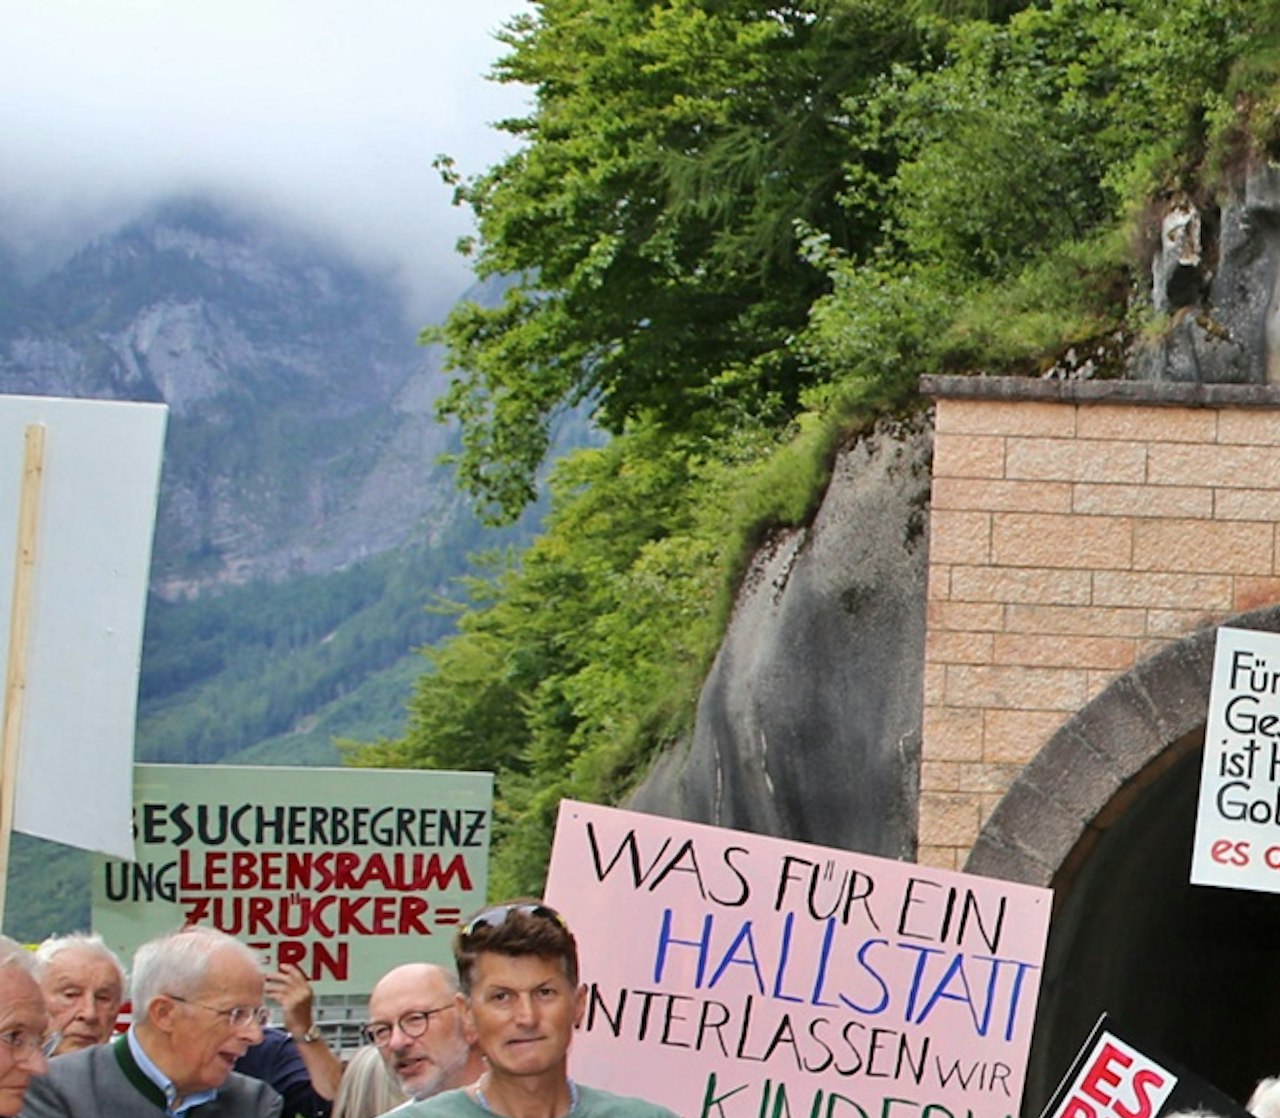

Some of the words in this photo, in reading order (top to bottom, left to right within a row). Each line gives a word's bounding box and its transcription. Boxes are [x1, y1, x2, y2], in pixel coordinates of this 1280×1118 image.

[1220, 739, 1260, 778] ist
[132, 803, 486, 847] ESUCHERBEGRENZ
[1210, 838, 1250, 866] es
[105, 862, 177, 902] UNG
[179, 850, 473, 892] LEBENSRAUM
[587, 822, 750, 906] WAS
[774, 856, 880, 931] FÜR
[897, 878, 1006, 954] EIN
[654, 909, 1039, 1042] HALLSTATT
[936, 1055, 1011, 1096] WIR
